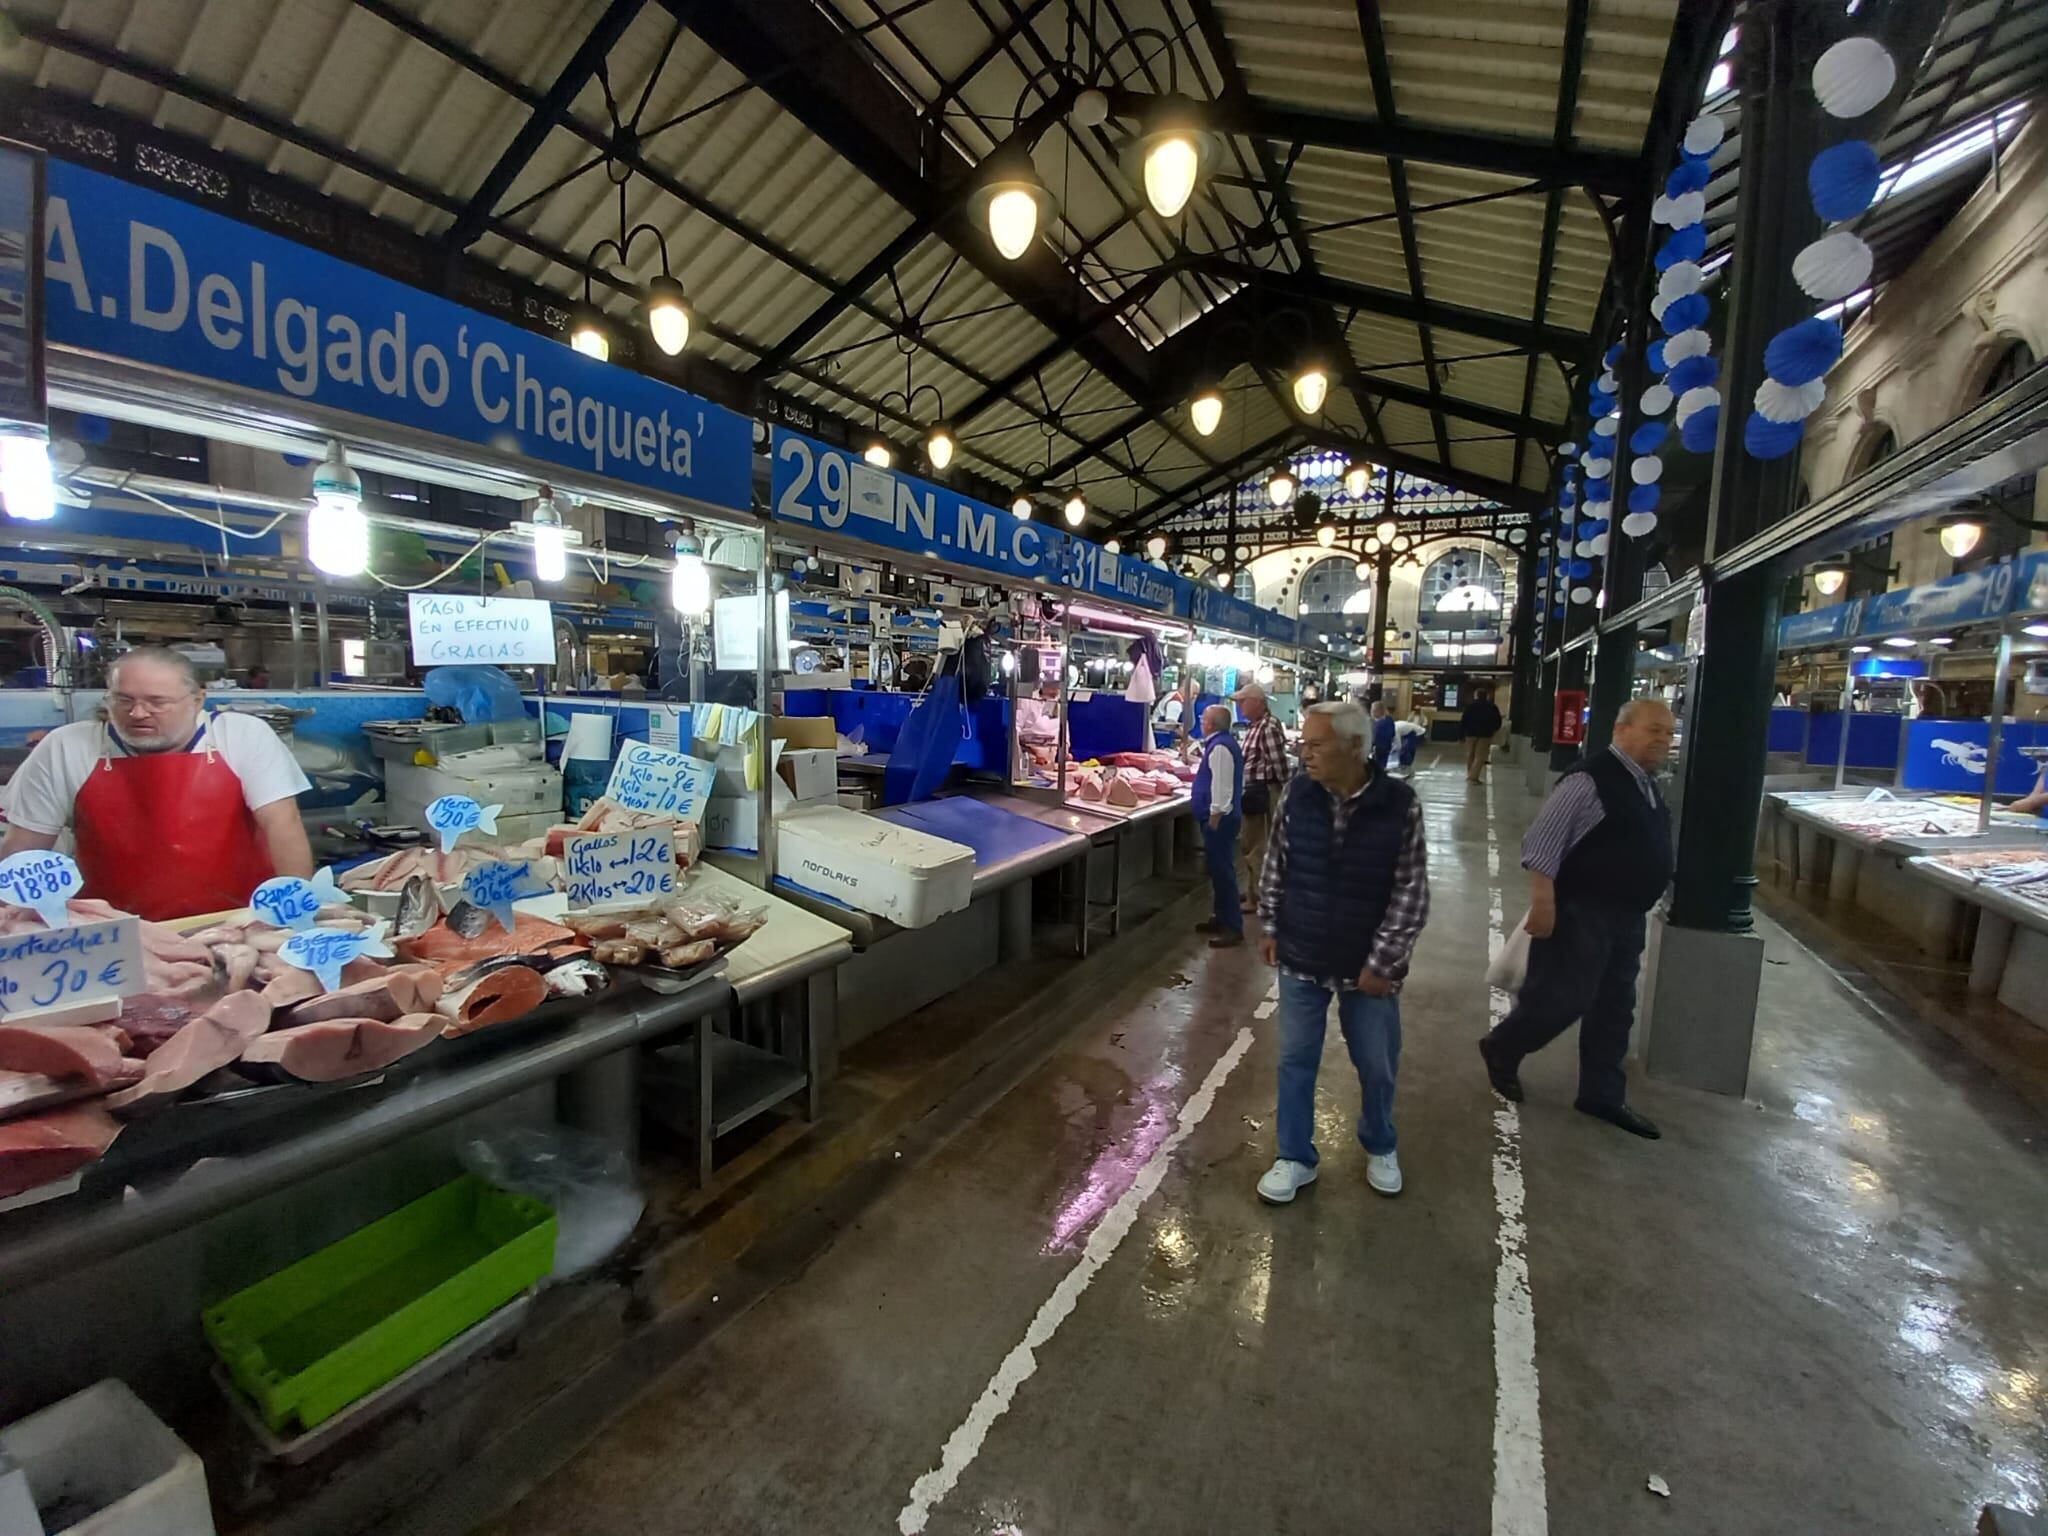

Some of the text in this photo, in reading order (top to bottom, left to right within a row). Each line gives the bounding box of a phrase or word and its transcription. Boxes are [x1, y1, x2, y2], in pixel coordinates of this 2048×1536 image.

[778, 438, 850, 528] 29
[1071, 541, 1096, 592] 31
[1117, 562, 1138, 597] Luis
[416, 598, 465, 616] PAGO
[1193, 585, 1209, 621] 33
[1983, 564, 2014, 615] 19
[419, 619, 530, 634] EN EFECTIVO
[1844, 600, 1862, 636] 18
[430, 640, 526, 660] GRACIAS
[628, 746, 701, 772] Cazón
